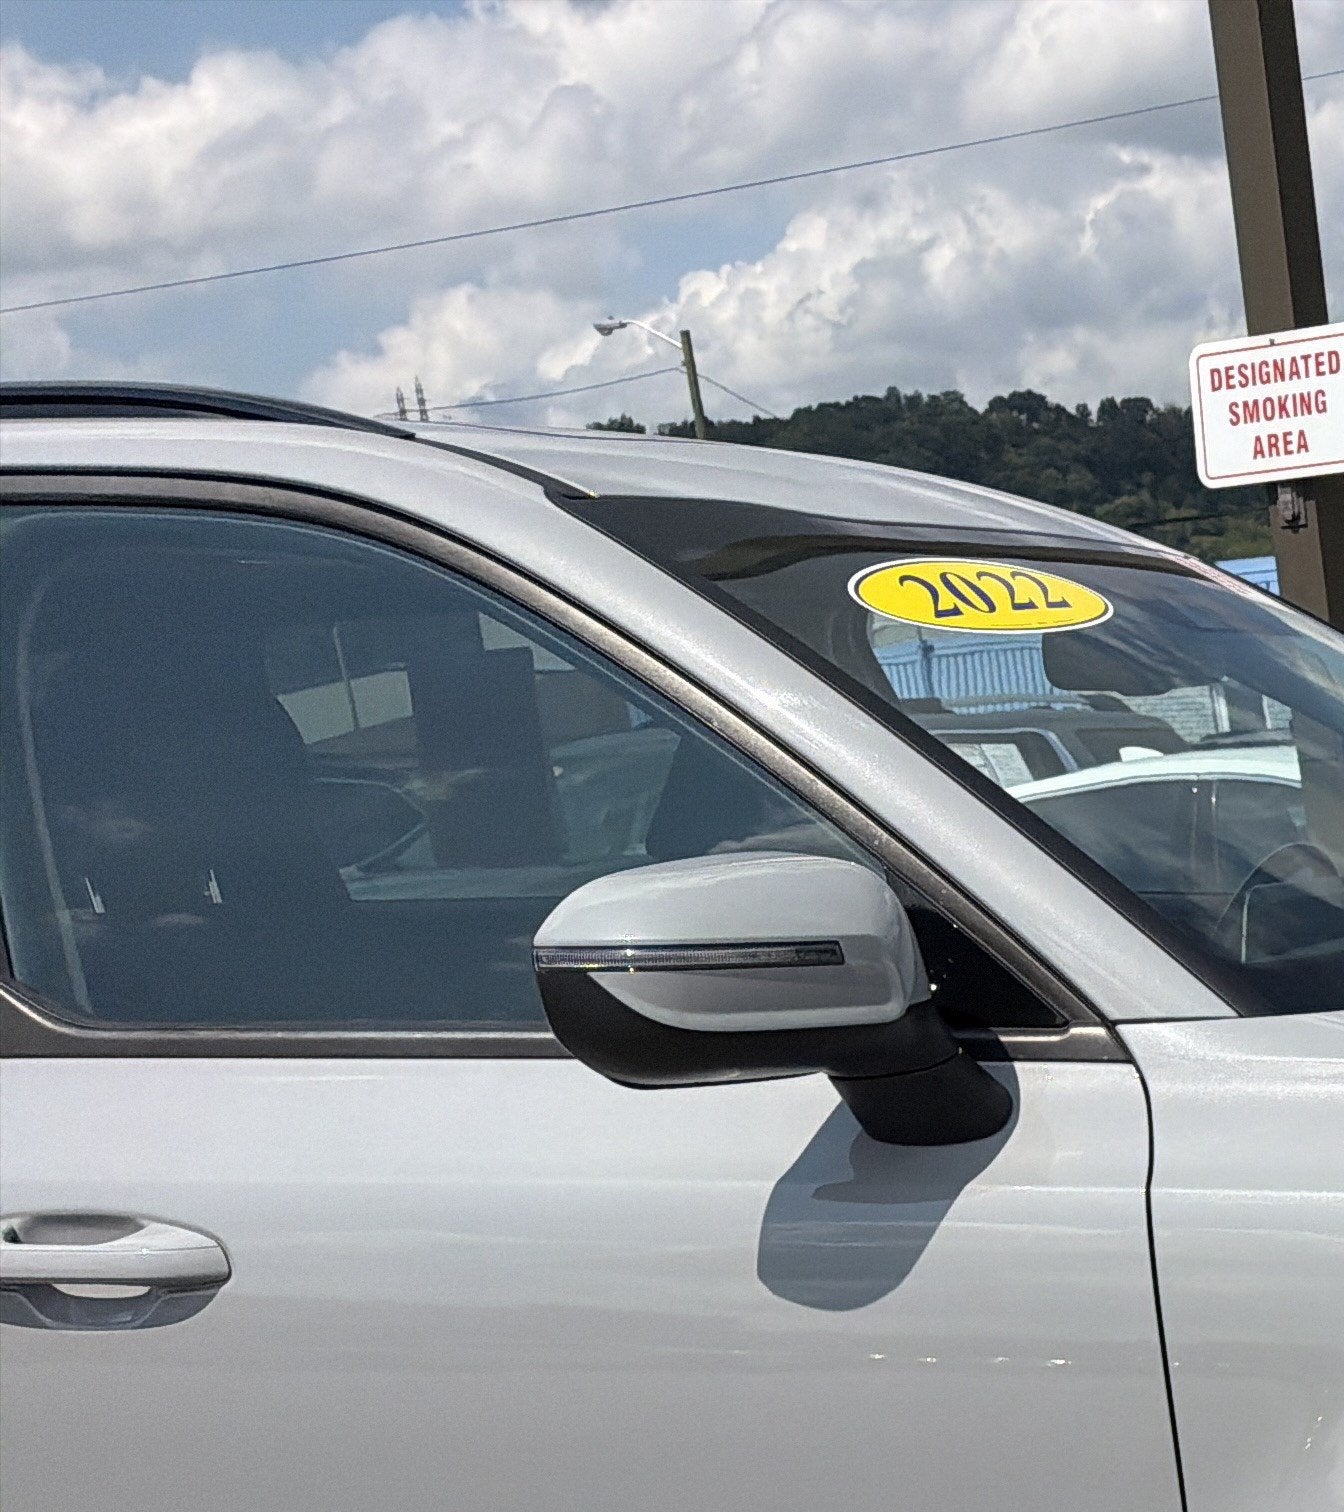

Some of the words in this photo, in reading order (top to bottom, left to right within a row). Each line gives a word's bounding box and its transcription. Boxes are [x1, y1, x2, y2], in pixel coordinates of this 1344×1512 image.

[1209, 350, 1341, 393] DESIGNATED
[1228, 389, 1328, 426] SMOKING
[1252, 429, 1310, 460] AREA
[898, 570, 1073, 619] 2022
